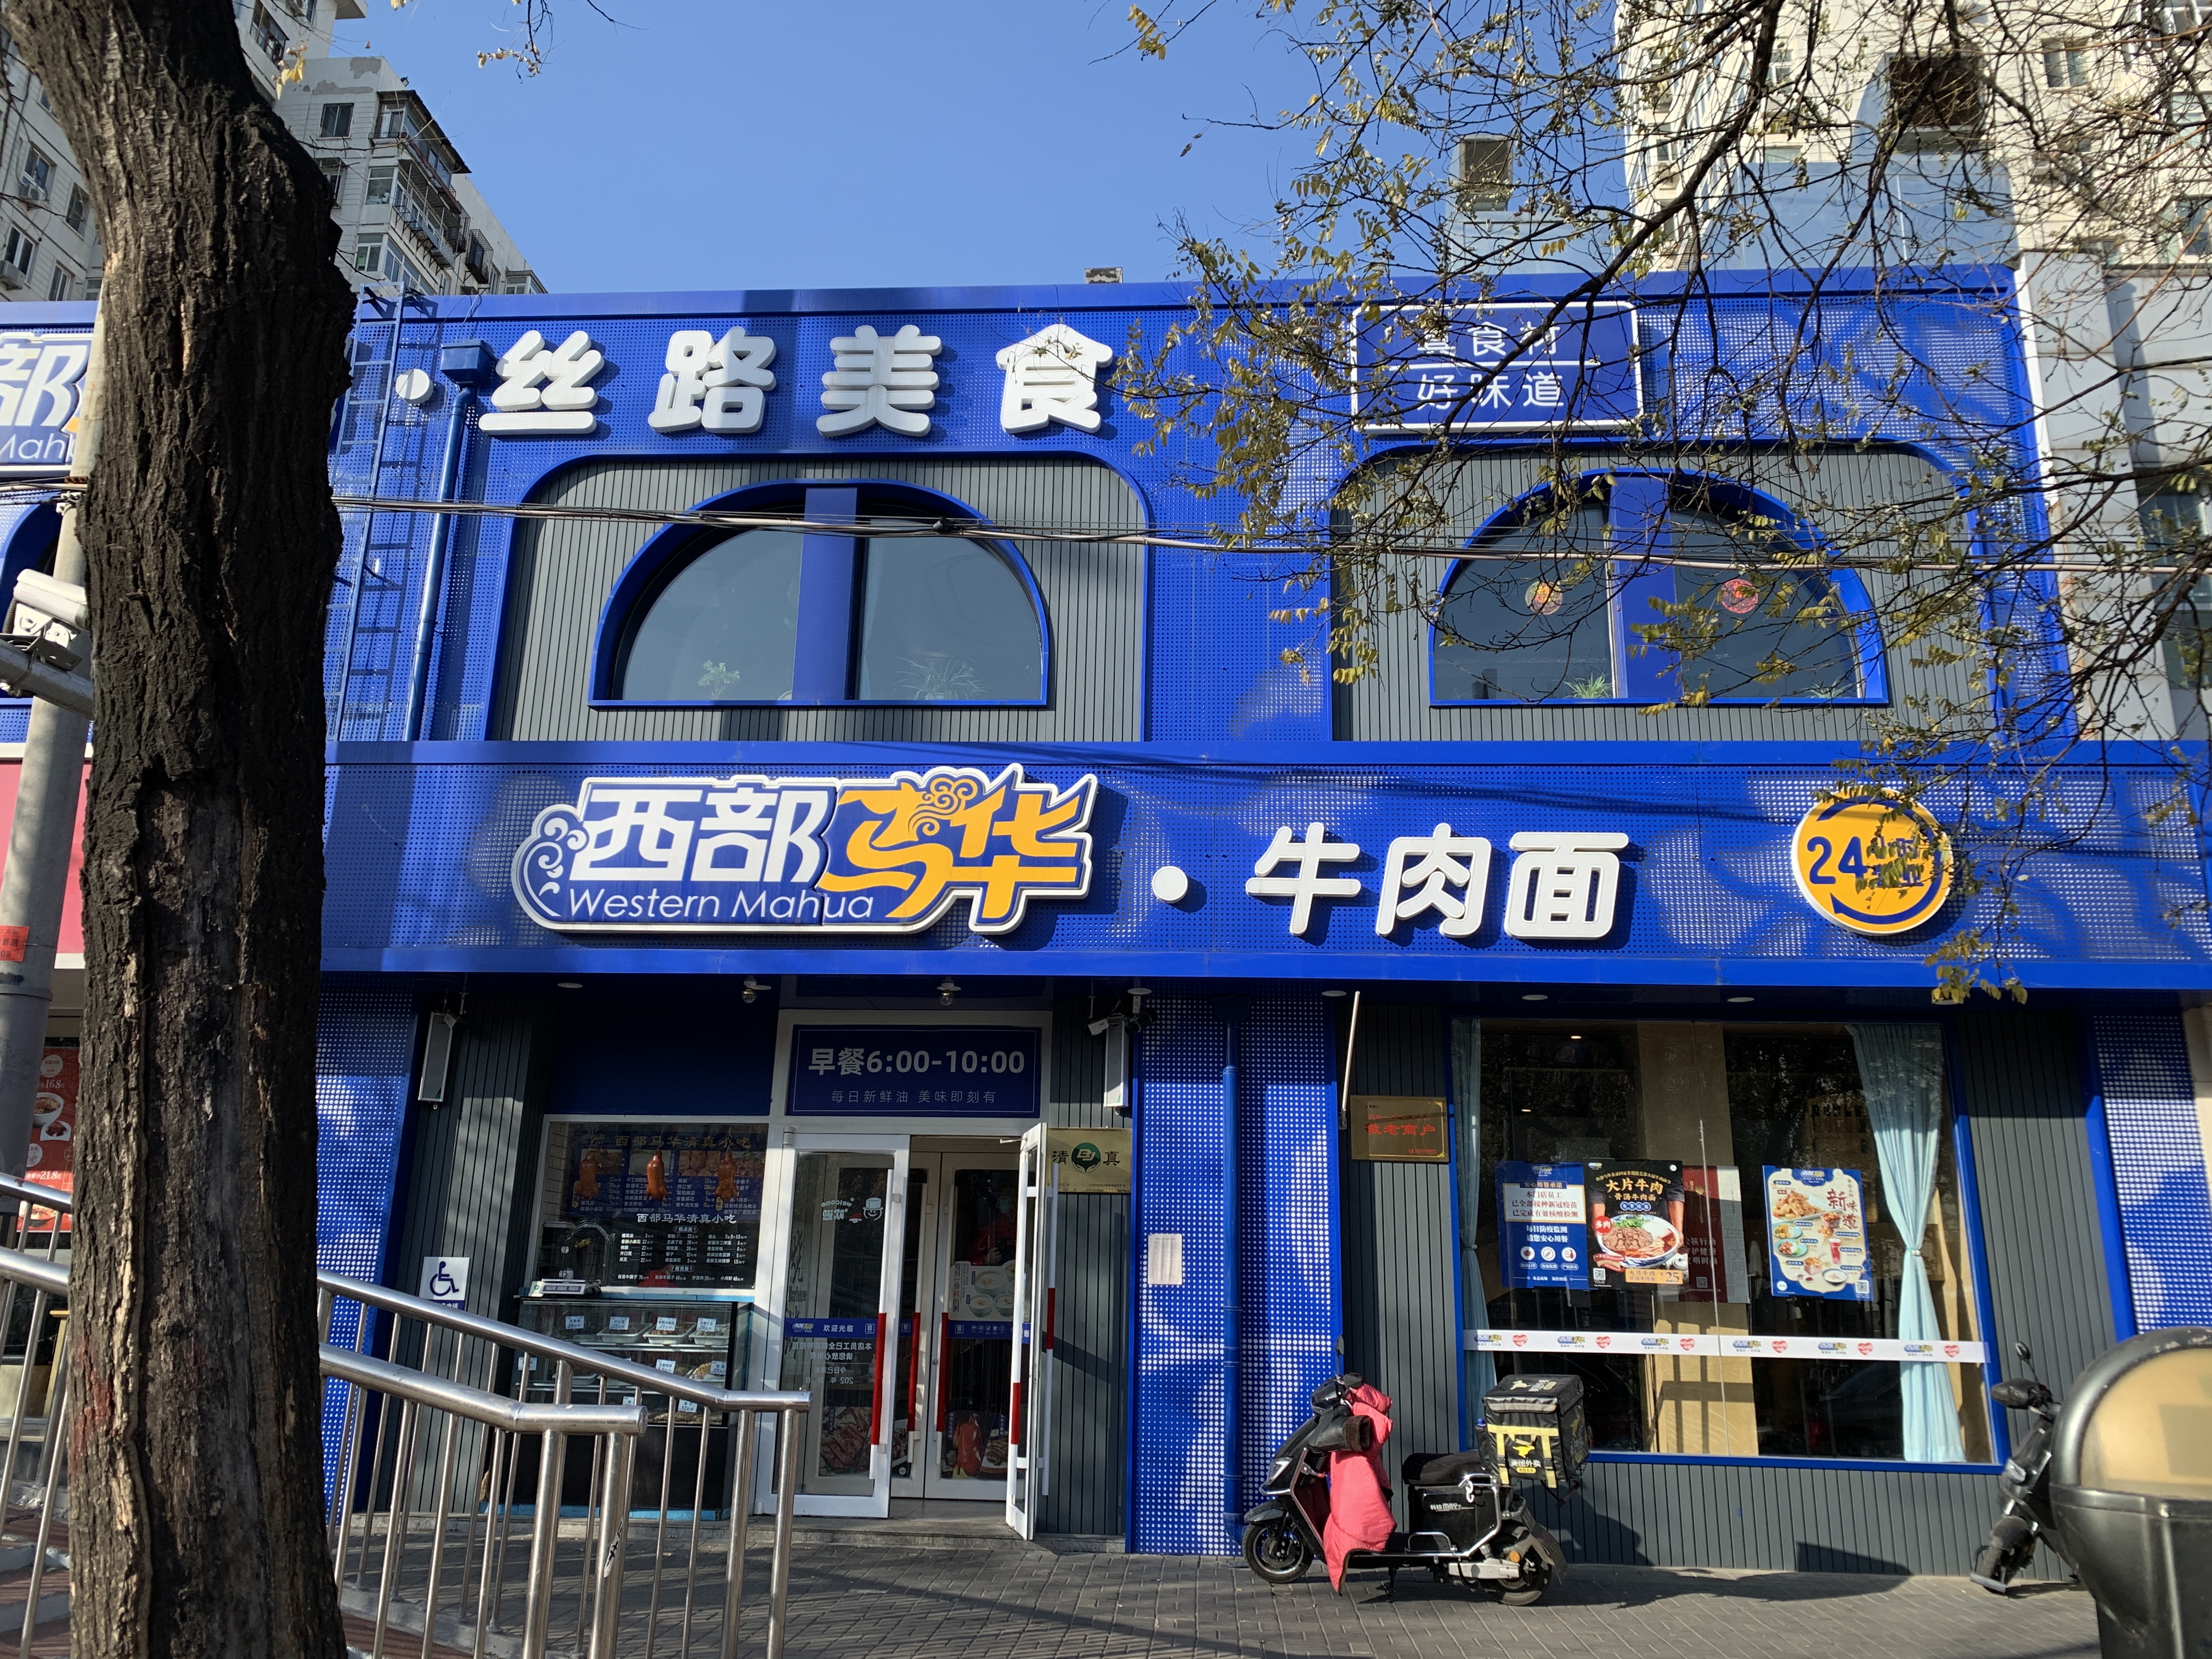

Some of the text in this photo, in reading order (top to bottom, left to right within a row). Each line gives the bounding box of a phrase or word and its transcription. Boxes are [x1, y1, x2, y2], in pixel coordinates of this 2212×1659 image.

[479, 324, 1114, 437] 丝路美食
[0, 343, 87, 432] 部
[1417, 370, 1564, 410] 好味道
[569, 779, 1078, 918] 西部马华
[1807, 836, 1867, 884] 24
[1245, 823, 1629, 939] 牛肉面
[569, 887, 873, 919] Western Mahua
[809, 1047, 1024, 1075] 早餐6:00-10:00
[831, 1090, 996, 1103] 每日新鲜油 美味即刻有
[1365, 1123, 1436, 1136] 敬老商户
[1605, 1177, 1664, 1195] 大片牛肉
[1526, 1190, 1563, 1199] 本门店员工
[1614, 1193, 1656, 1201] 骨汤牛肉面
[1512, 1200, 1578, 1209] 已全部接种新冠疫苗
[636, 1214, 736, 1223] 西部马华清真小吃
[1513, 1209, 1579, 1218] 已完成有效核酸检测
[1526, 1224, 1568, 1233] 每日防疫监测
[1596, 1220, 1611, 1229] 多肉
[1527, 1234, 1568, 1243] 请您安心用餐
[823, 1324, 854, 1333] 欢迎光临
[1510, 1459, 1542, 1468] 美团外卖
